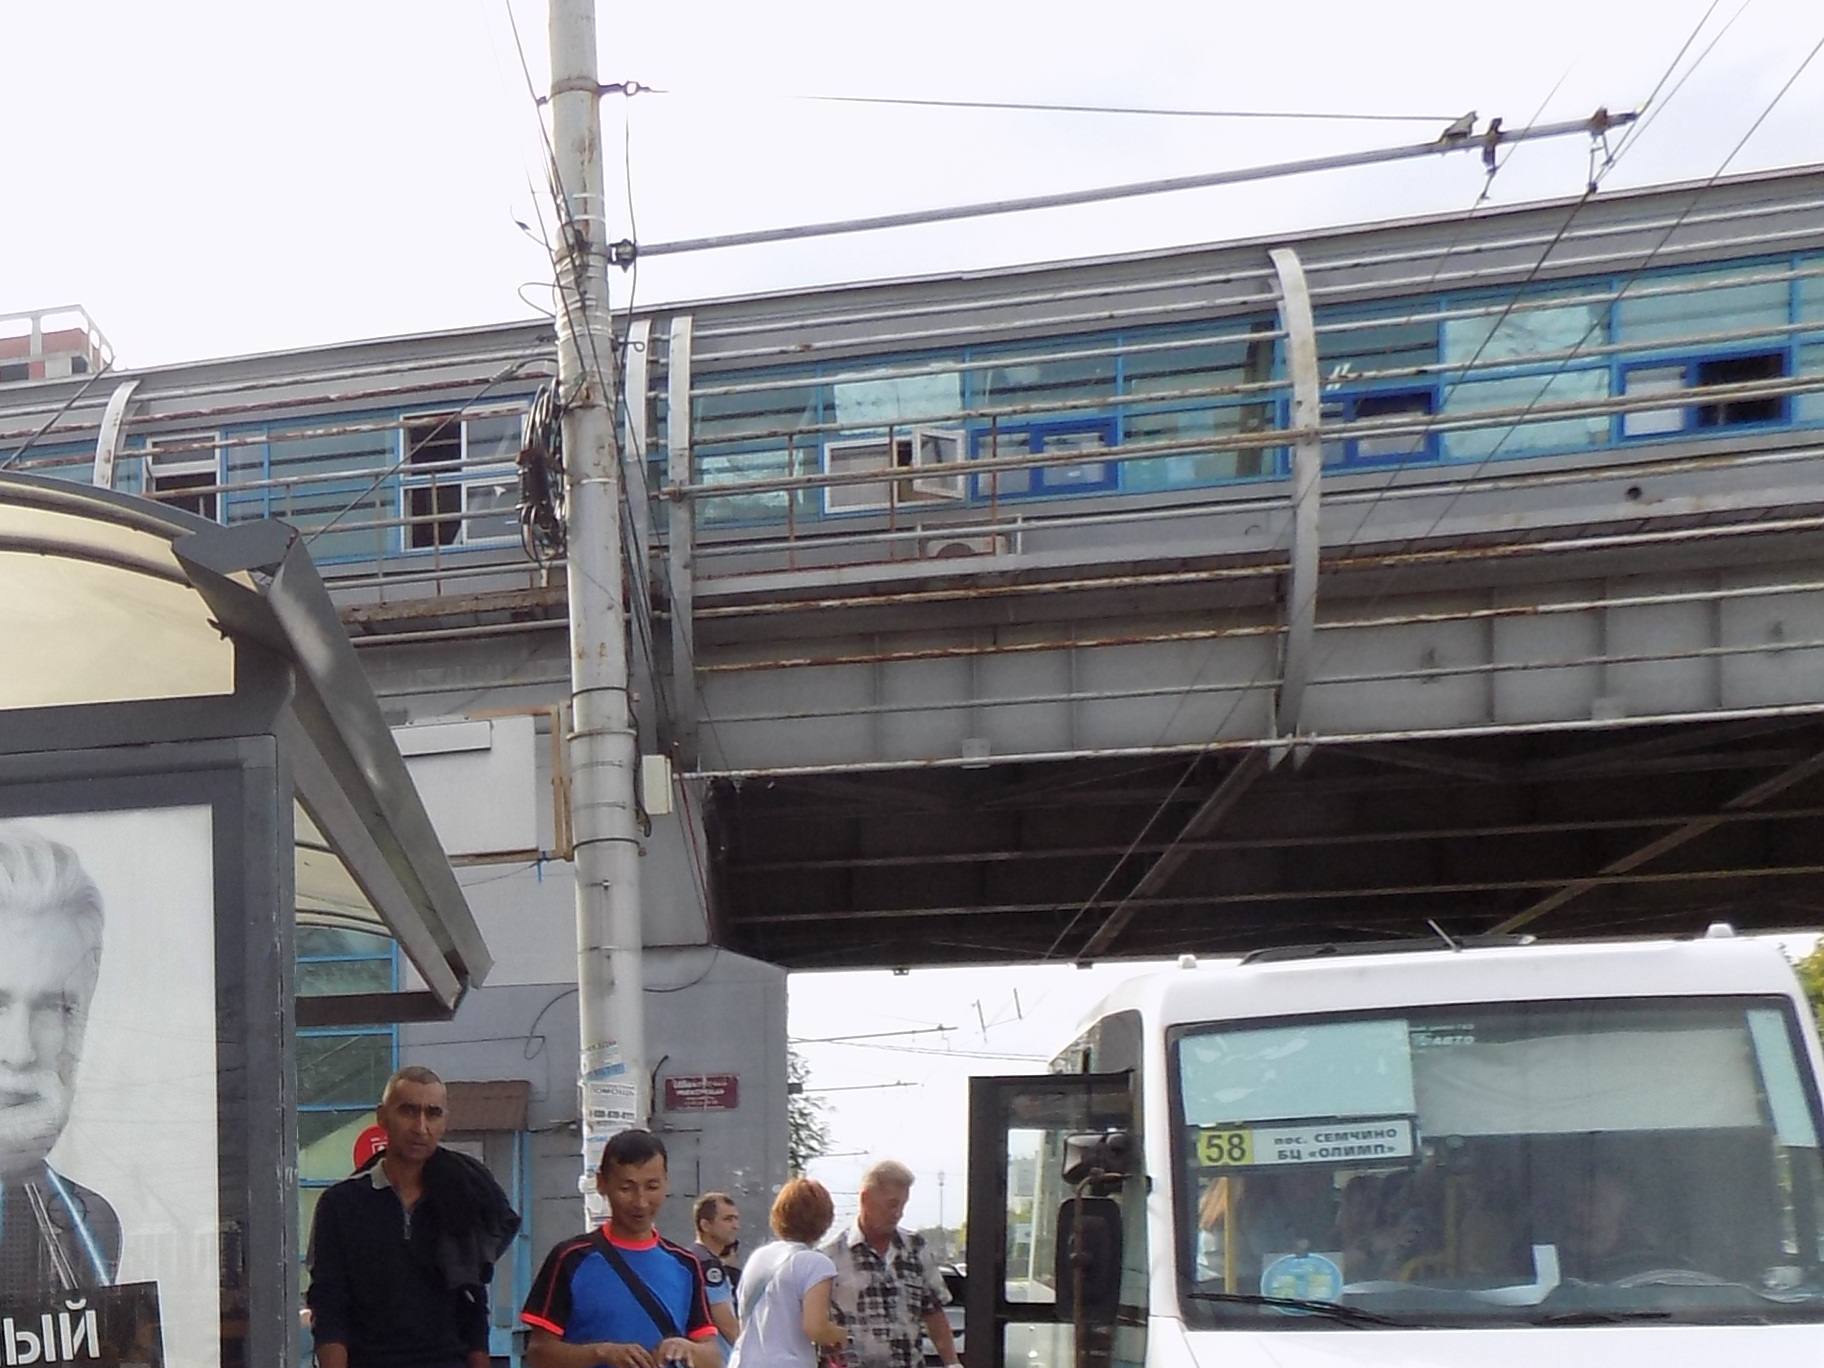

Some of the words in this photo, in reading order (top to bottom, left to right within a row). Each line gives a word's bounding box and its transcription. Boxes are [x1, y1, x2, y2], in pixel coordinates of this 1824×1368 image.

[1205, 1132, 1246, 1163] 58
[1273, 1135, 1307, 1146] пос.
[1314, 1128, 1397, 1144] СЕМЧИНО
[1277, 1149, 1302, 1160] БЦ
[1307, 1144, 1396, 1159] «ОЛИМП»
